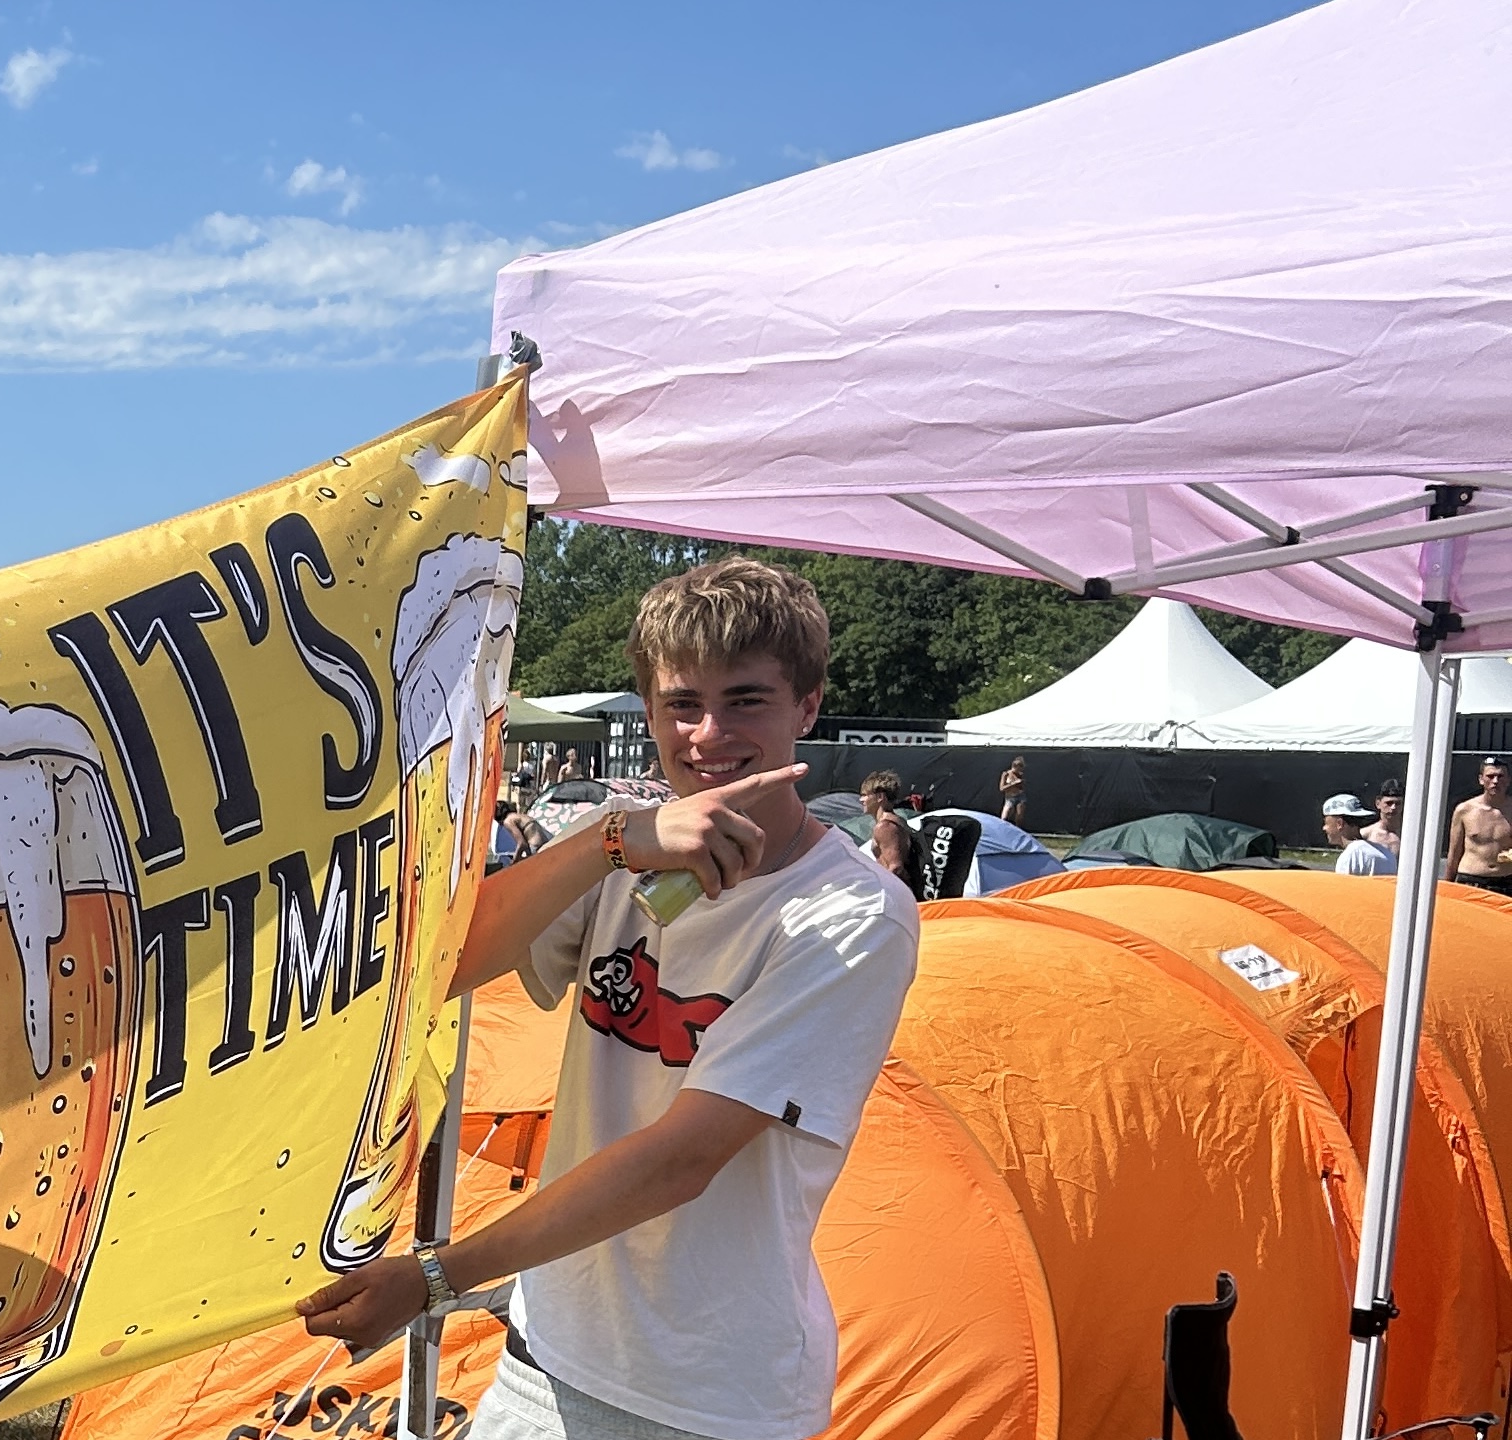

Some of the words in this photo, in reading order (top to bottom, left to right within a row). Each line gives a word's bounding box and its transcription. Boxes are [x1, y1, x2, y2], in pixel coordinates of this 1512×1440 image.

[46, 512, 383, 876] IT'S
[140, 810, 396, 1111] TIME
[922, 825, 954, 902] adidas
